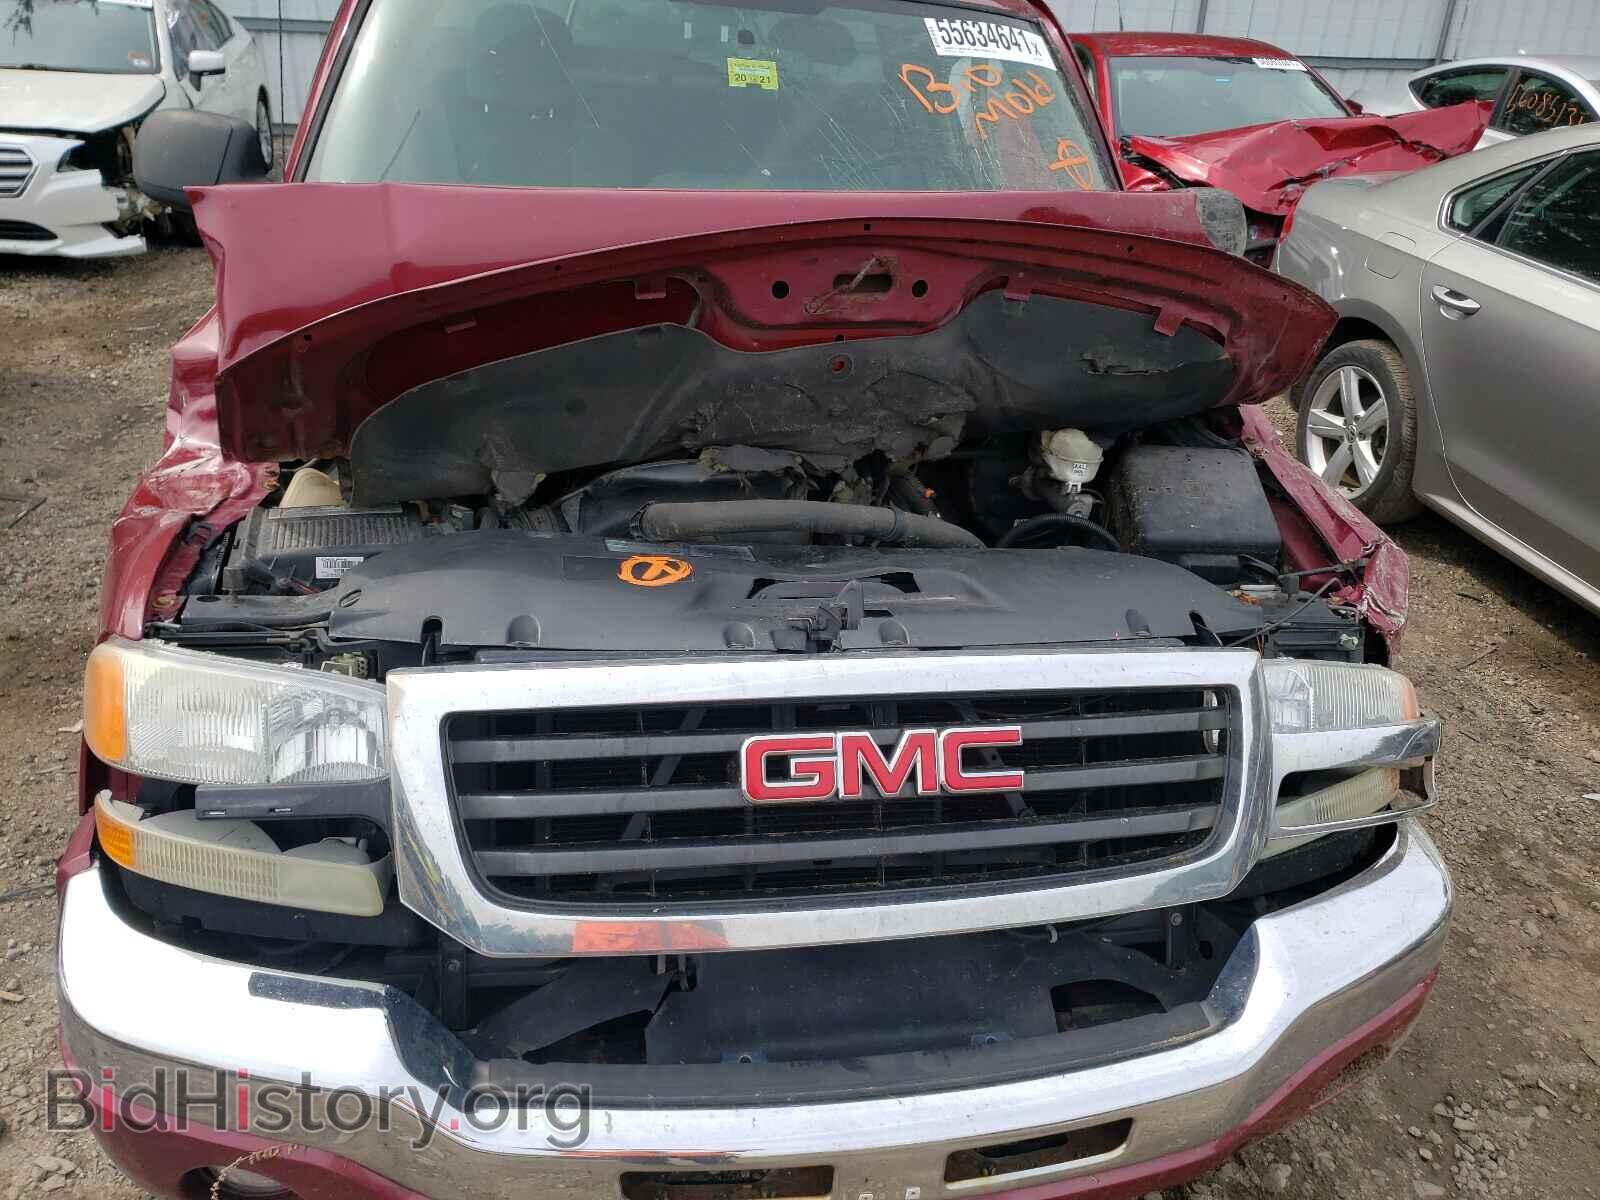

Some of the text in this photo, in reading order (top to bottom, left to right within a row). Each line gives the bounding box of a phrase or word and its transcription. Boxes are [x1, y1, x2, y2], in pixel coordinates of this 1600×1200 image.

[937, 19, 1032, 54] 55634641
[735, 73, 770, 84] 20 21
[741, 726, 1024, 802] GMC
